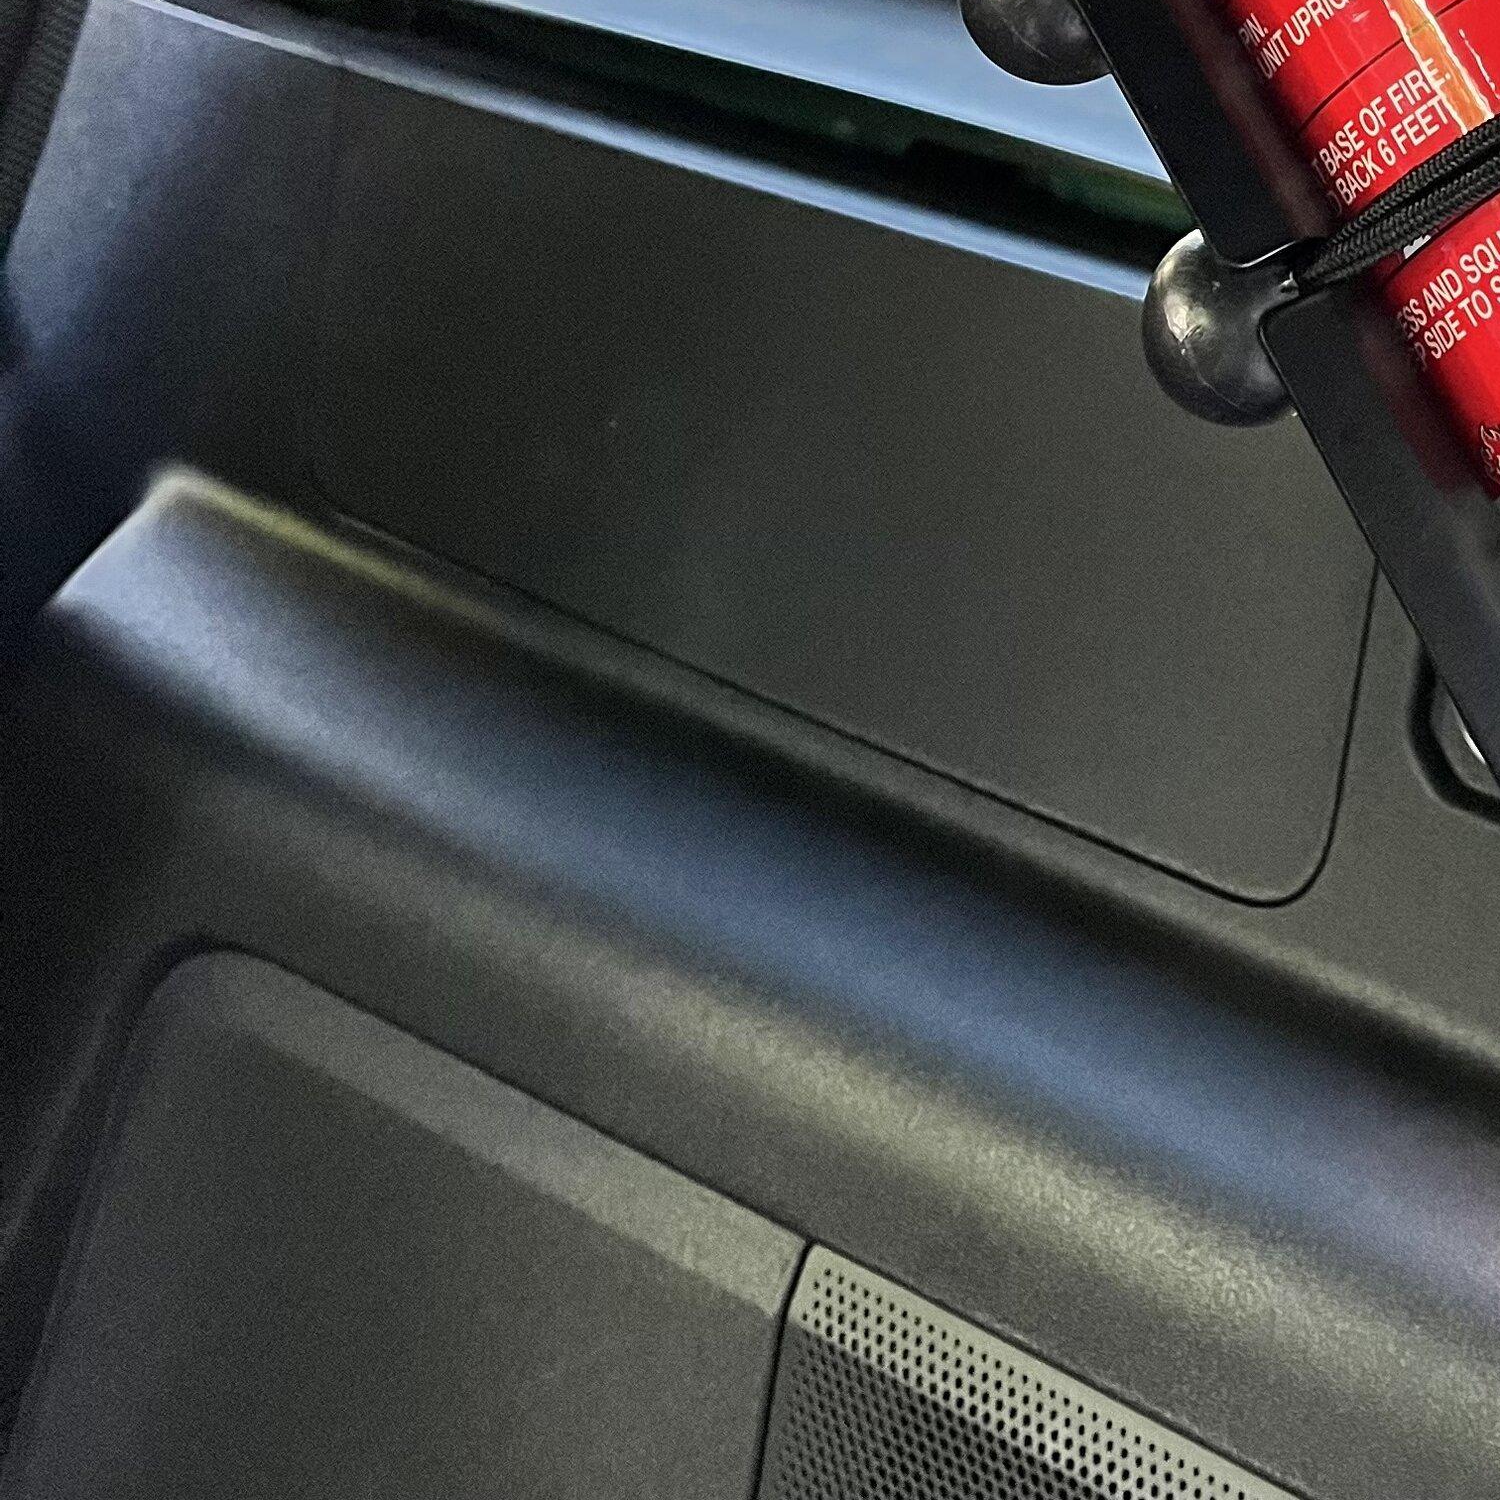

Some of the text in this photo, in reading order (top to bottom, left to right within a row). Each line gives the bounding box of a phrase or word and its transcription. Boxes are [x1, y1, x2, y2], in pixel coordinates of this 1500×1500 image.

[1256, 30, 1290, 79] UNIT
[1320, 121, 1364, 176] BASE
[1359, 97, 1389, 137] OF
[1335, 150, 1384, 205] BACK
[1377, 139, 1397, 166] 6
[1422, 270, 1464, 315] AND
[1424, 315, 1467, 359] SIDE
[1458, 289, 1494, 328] TO
